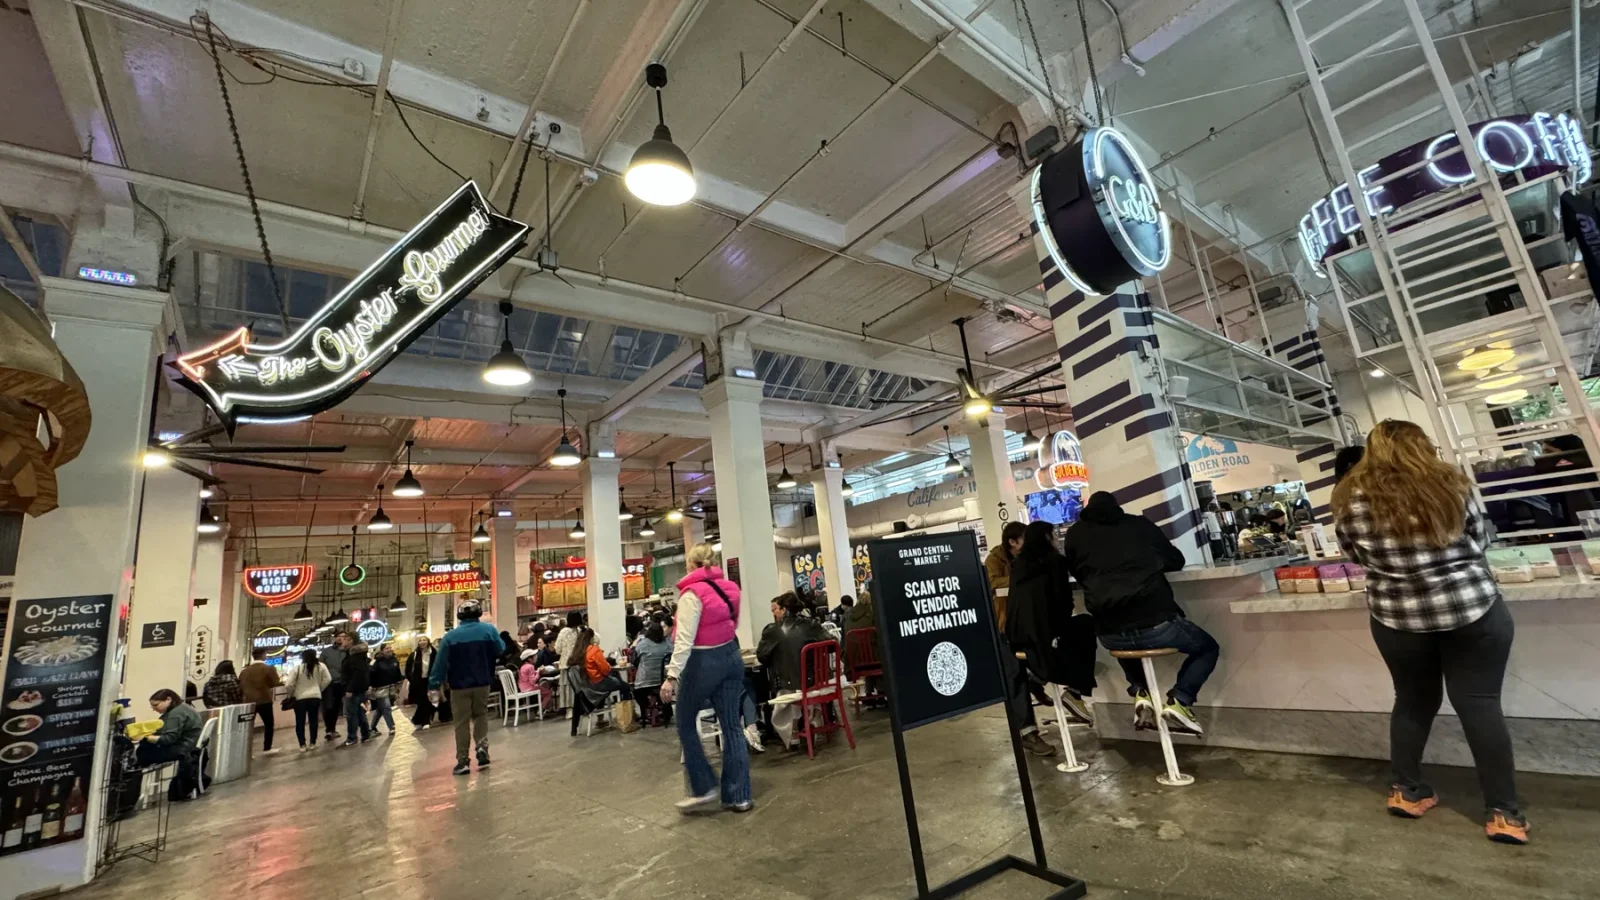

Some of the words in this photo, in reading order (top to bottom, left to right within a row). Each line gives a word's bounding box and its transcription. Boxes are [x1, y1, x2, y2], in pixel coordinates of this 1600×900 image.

[1221, 455, 1250, 467] ROAD
[898, 547, 922, 558] GRAND
[923, 544, 953, 555] CENTRAL
[794, 553, 813, 573] LOS
[914, 554, 941, 566] MARKET
[250, 568, 299, 578] FILIPINO
[429, 564, 451, 573] CHINA
[453, 563, 470, 571] CAFE
[542, 568, 586, 580] CHIN
[262, 576, 288, 585] RICE
[419, 574, 449, 584] CHOP
[452, 572, 478, 581] SUEY
[256, 584, 291, 593] BOWLS
[420, 583, 450, 593] CHOW
[454, 581, 479, 590] MEIN
[904, 580, 936, 598] SCAN
[938, 576, 961, 593] FOR
[912, 594, 959, 615] VENDOR
[25, 600, 106, 625] Oyster
[24, 619, 103, 635] Gourmet
[899, 608, 978, 637] INFORMATION
[359, 626, 383, 634] SUSHI
[254, 636, 290, 648] MARKET
[359, 633, 383, 641] RUSH
[195, 631, 206, 666] PICKUP
[52, 690, 89, 699] Cocktail
[46, 763, 71, 772] Beer
[7, 770, 75, 786] Champagne
